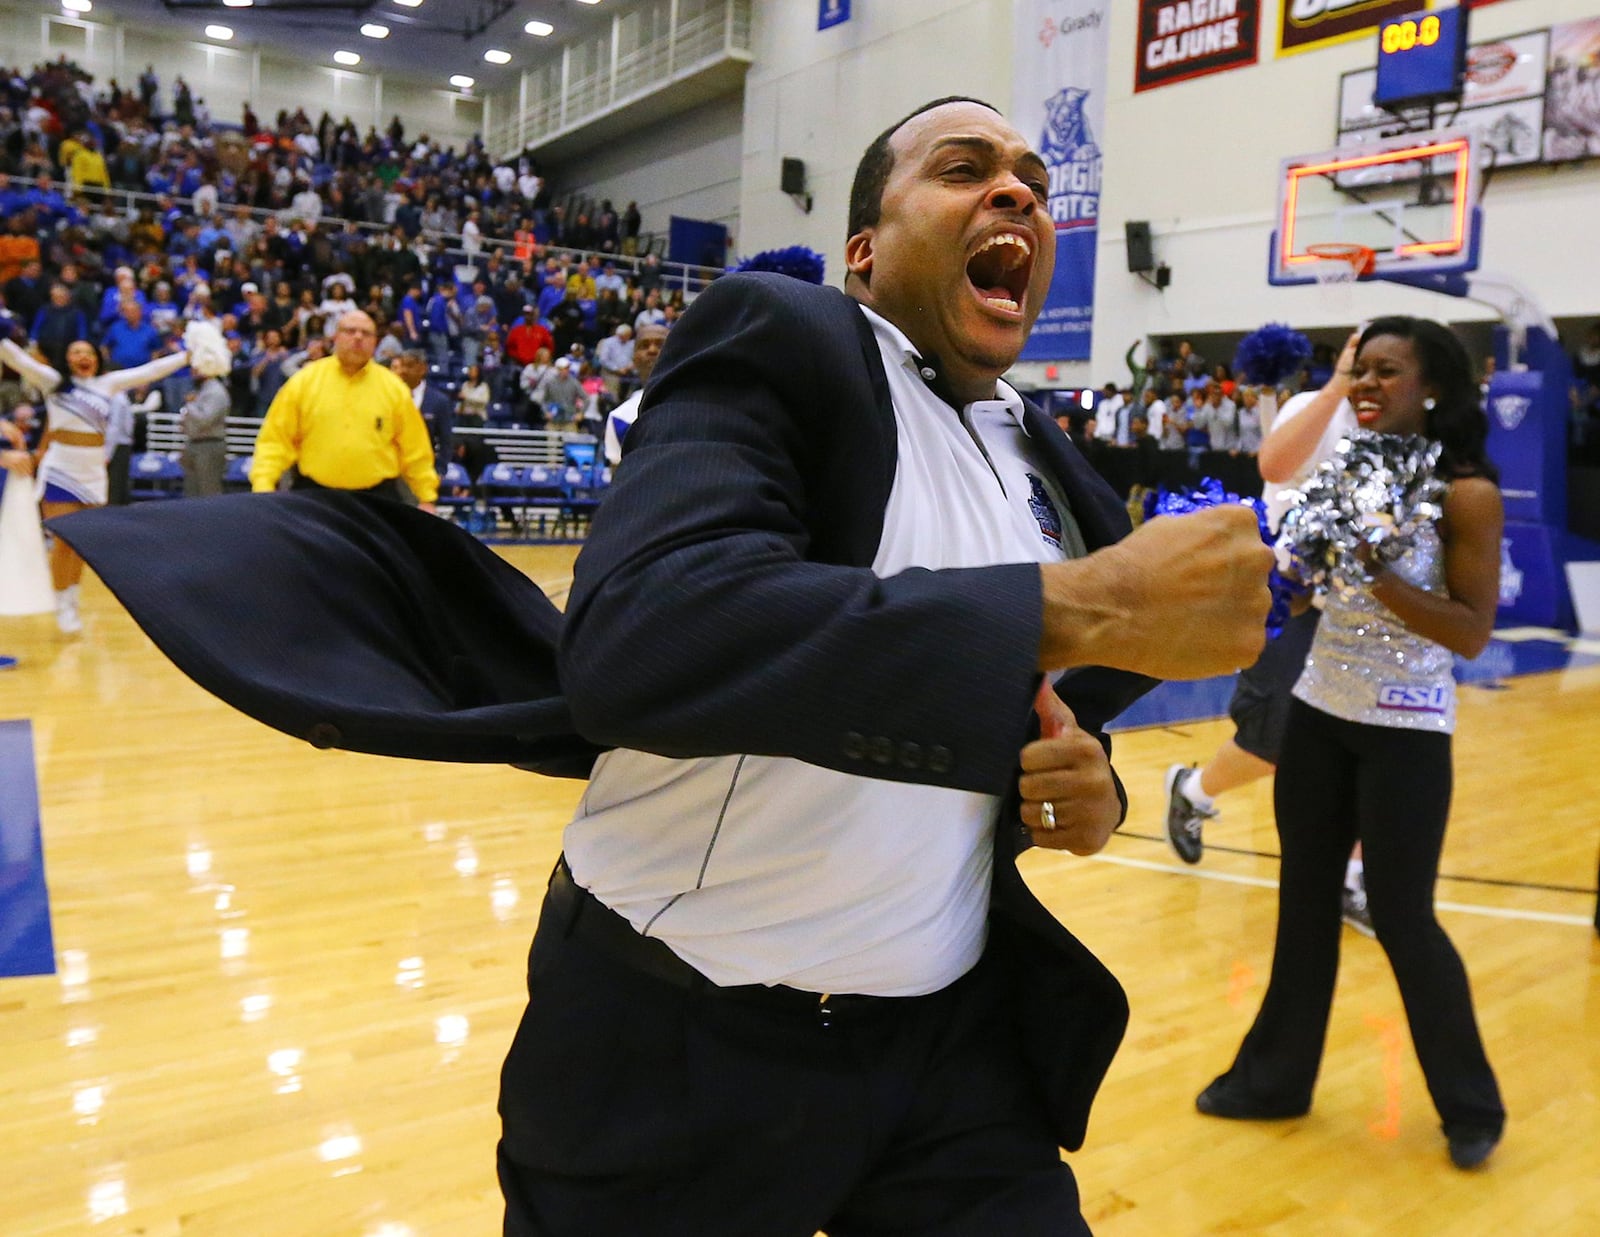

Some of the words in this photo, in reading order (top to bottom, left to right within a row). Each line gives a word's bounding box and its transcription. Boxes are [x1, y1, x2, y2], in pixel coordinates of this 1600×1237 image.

[1060, 9, 1104, 34] Grady
[1382, 15, 1440, 54] 00.0
[1145, 17, 1240, 70] CAJUNS
[1048, 195, 1098, 221] ATE
[1379, 685, 1449, 708] GSU
